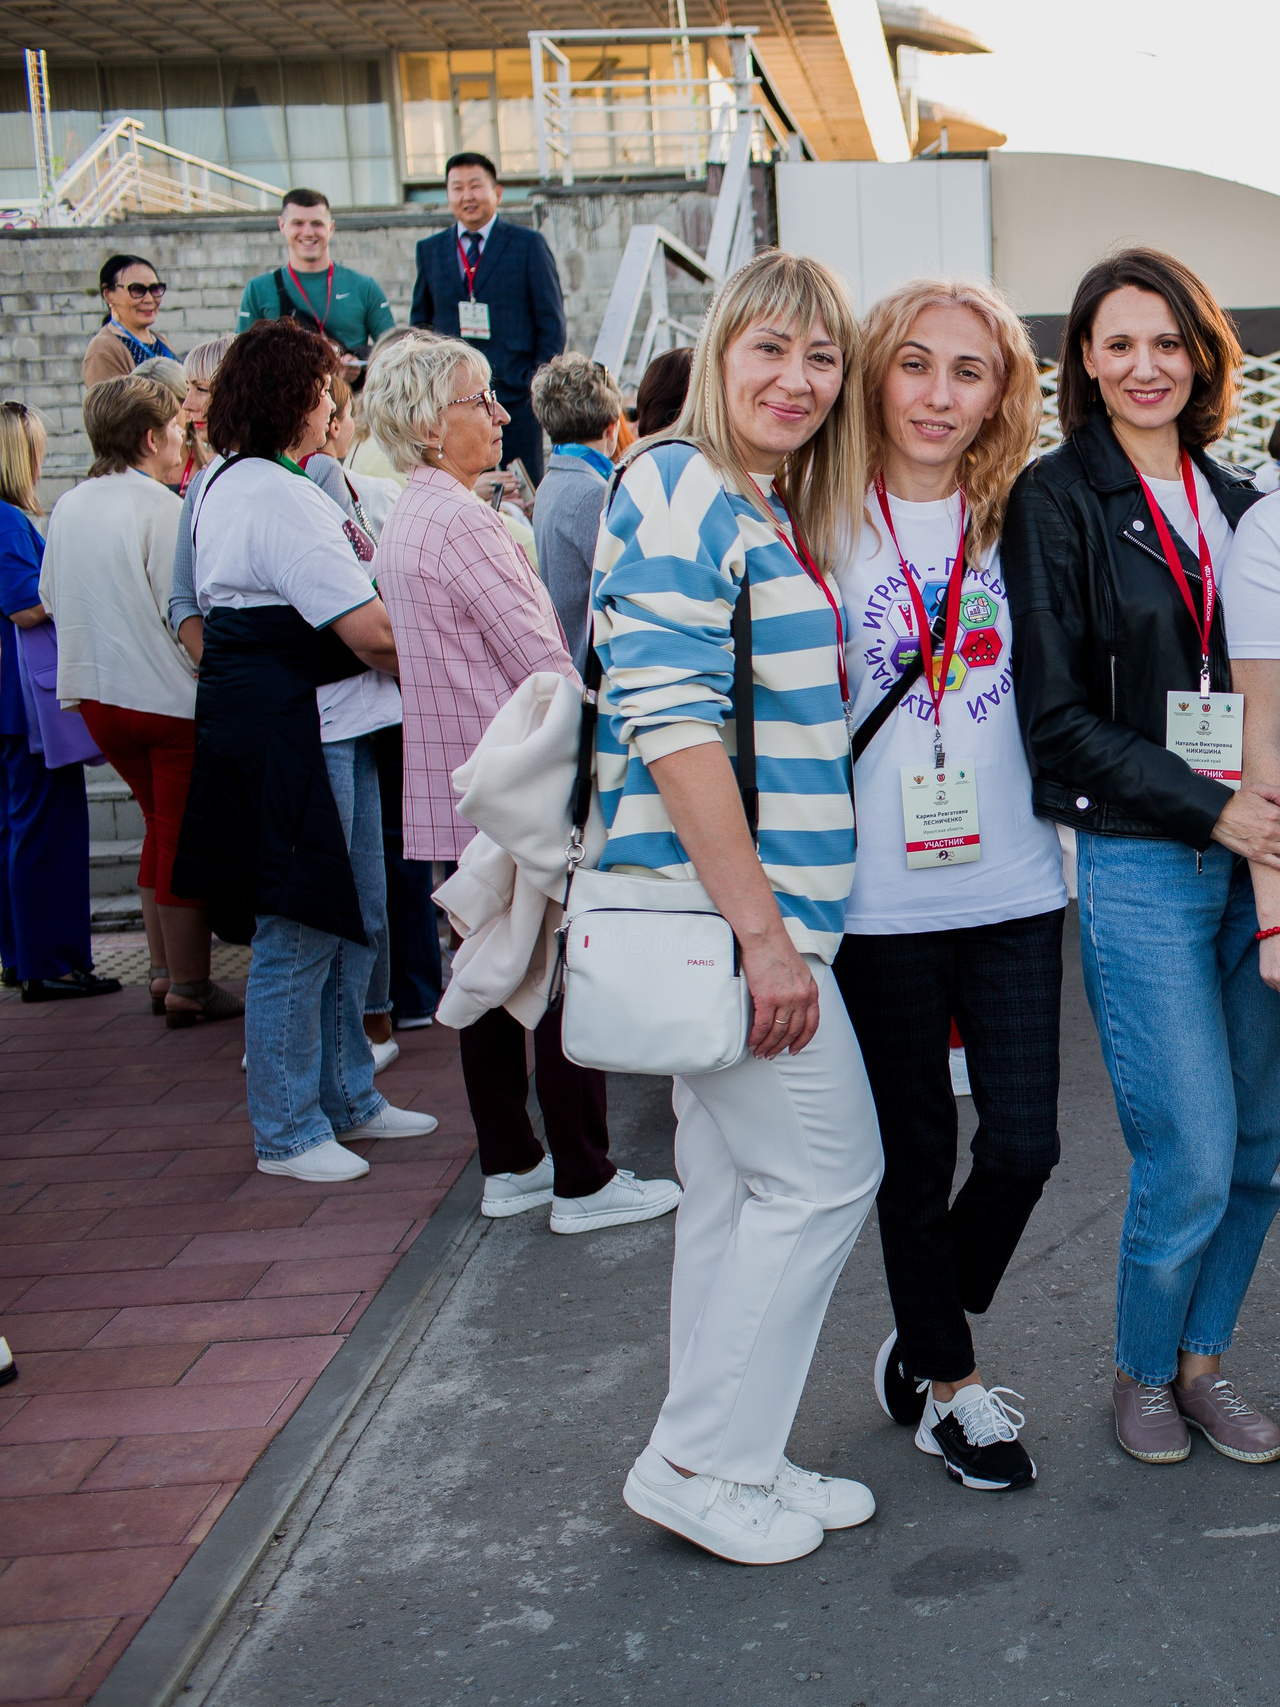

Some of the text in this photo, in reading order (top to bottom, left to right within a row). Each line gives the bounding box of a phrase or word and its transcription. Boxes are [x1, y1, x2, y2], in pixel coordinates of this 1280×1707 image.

[863, 559, 921, 629] ИГРАЙ
[916, 812, 937, 820] Карина
[923, 816, 963, 826] ЛЕСНИЧЕНКО
[923, 837, 965, 850] УЧАСТНИК
[686, 959, 715, 967] PARIS
